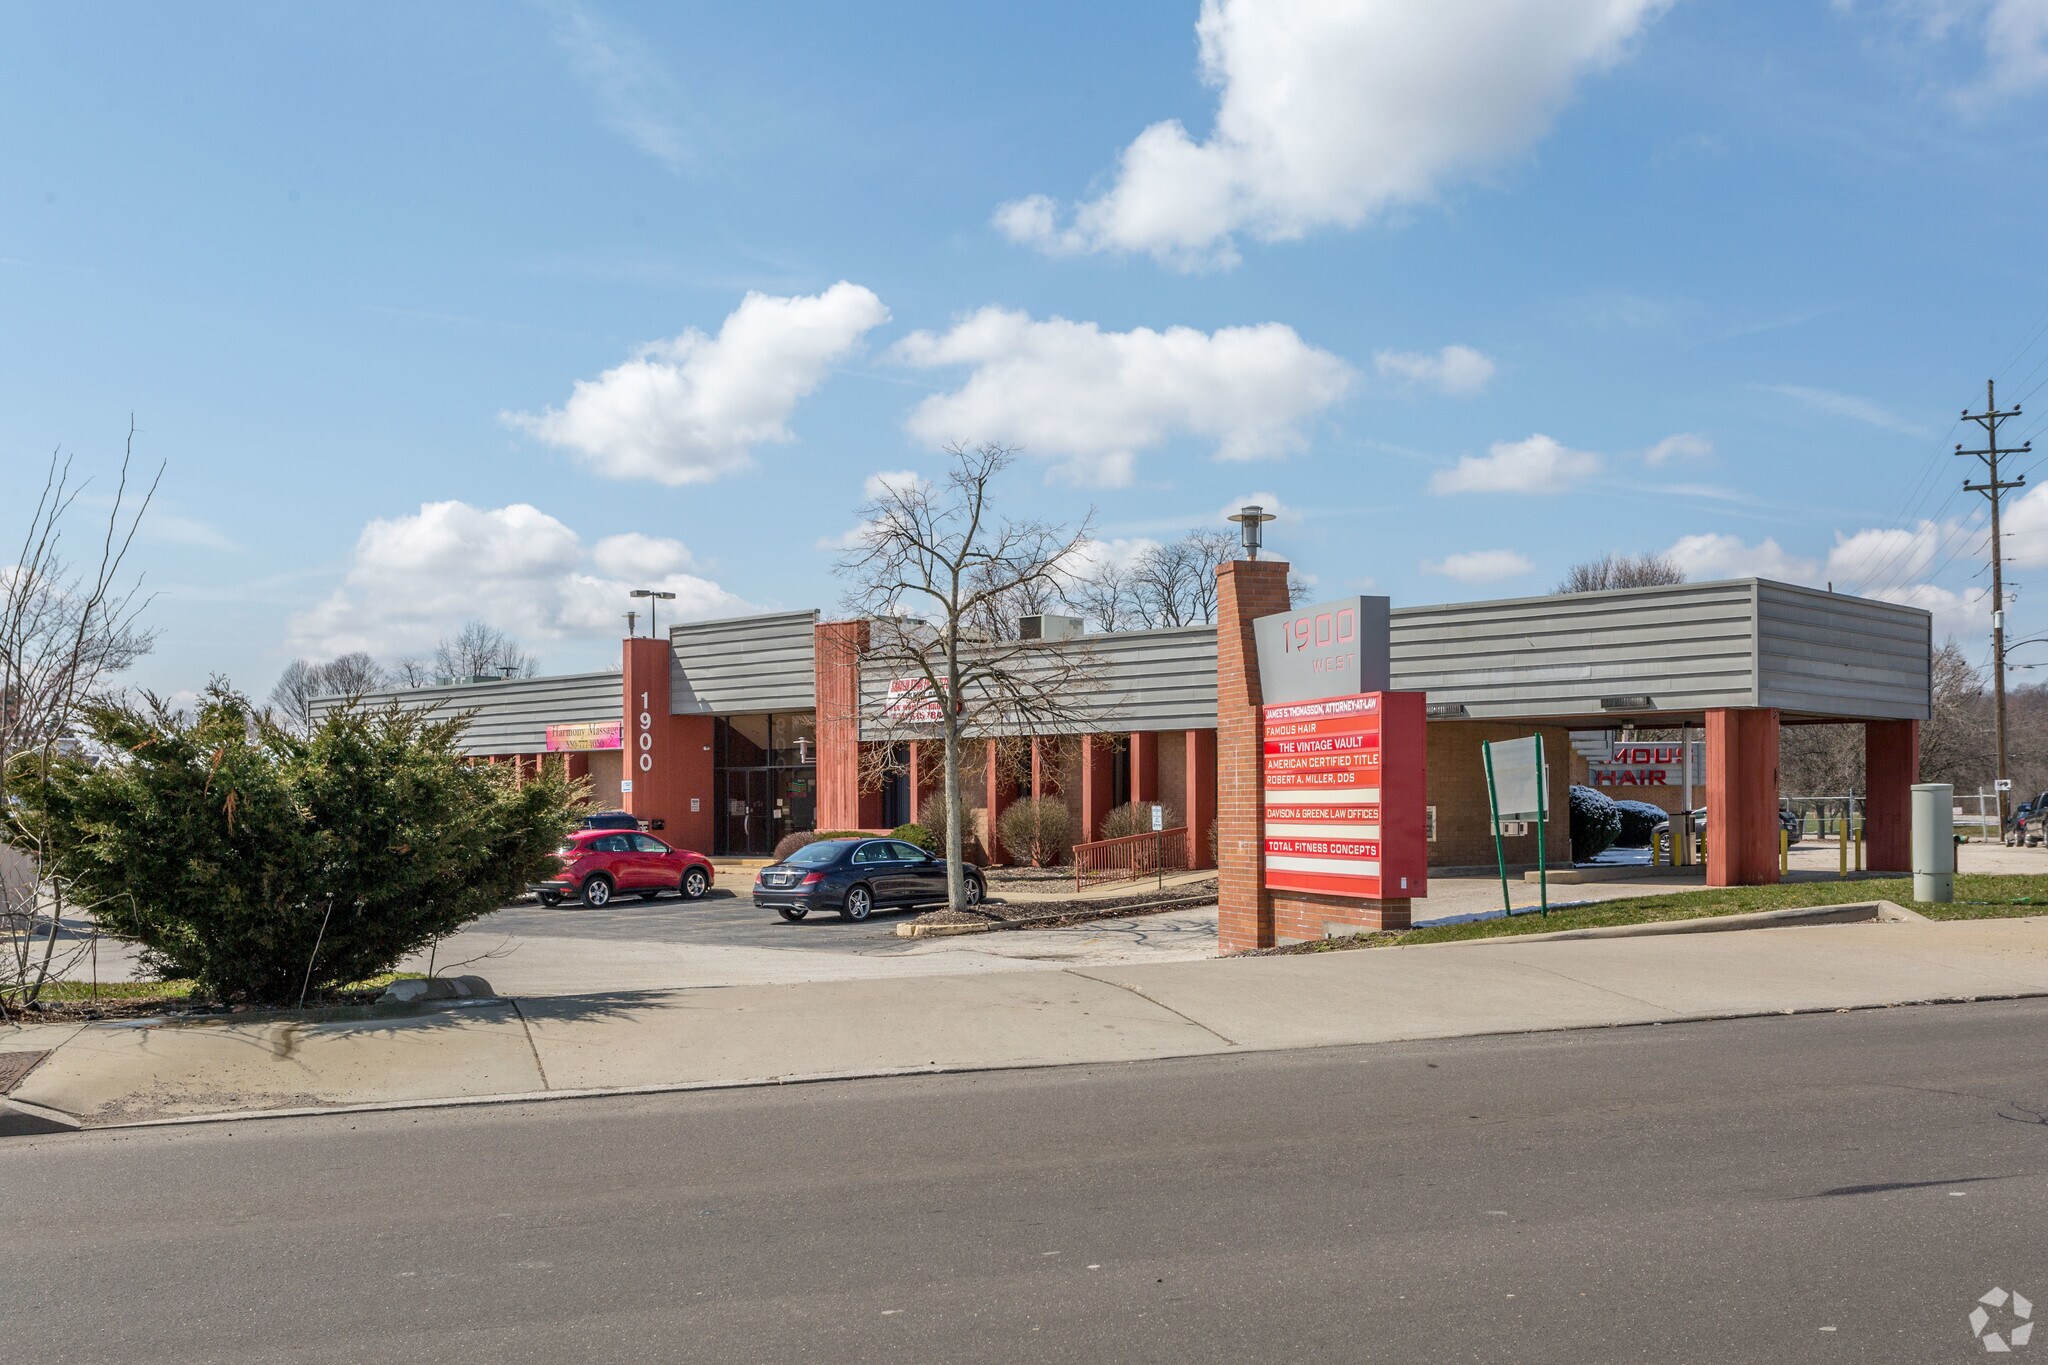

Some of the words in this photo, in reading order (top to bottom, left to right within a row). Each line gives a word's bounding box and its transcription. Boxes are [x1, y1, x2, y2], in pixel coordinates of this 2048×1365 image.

[1283, 608, 1355, 653] 1900
[1312, 653, 1355, 673] WEST
[1265, 708, 1283, 719] JAMES
[552, 725, 585, 738] Harmony
[588, 723, 618, 736] Massage
[639, 691, 653, 772] 1900
[1266, 725, 1296, 736] FAMOUS
[1298, 723, 1316, 733] HAIR
[1279, 743, 1295, 753] THE
[1296, 739, 1333, 751] VINTAGE
[1334, 736, 1363, 749] VAULT
[1268, 757, 1308, 769] AMERICAN
[1309, 755, 1351, 768] CERTIFIED
[1353, 754, 1379, 765] TITLE
[1267, 775, 1295, 784] ROBERT
[1296, 775, 1304, 784] A.
[1305, 773, 1336, 784] MILLER,
[1337, 773, 1355, 783] DDS
[1597, 770, 1667, 785] HAIR
[1267, 809, 1294, 818] DAVISON
[1296, 809, 1300, 818] &
[1302, 809, 1329, 818] GREENE
[1330, 809, 1346, 818] LAW
[1347, 809, 1379, 819] OFFICES
[1269, 841, 1293, 851] TOTAL
[1294, 842, 1328, 853] FITNESS
[1330, 844, 1376, 856] CONCEPTS
